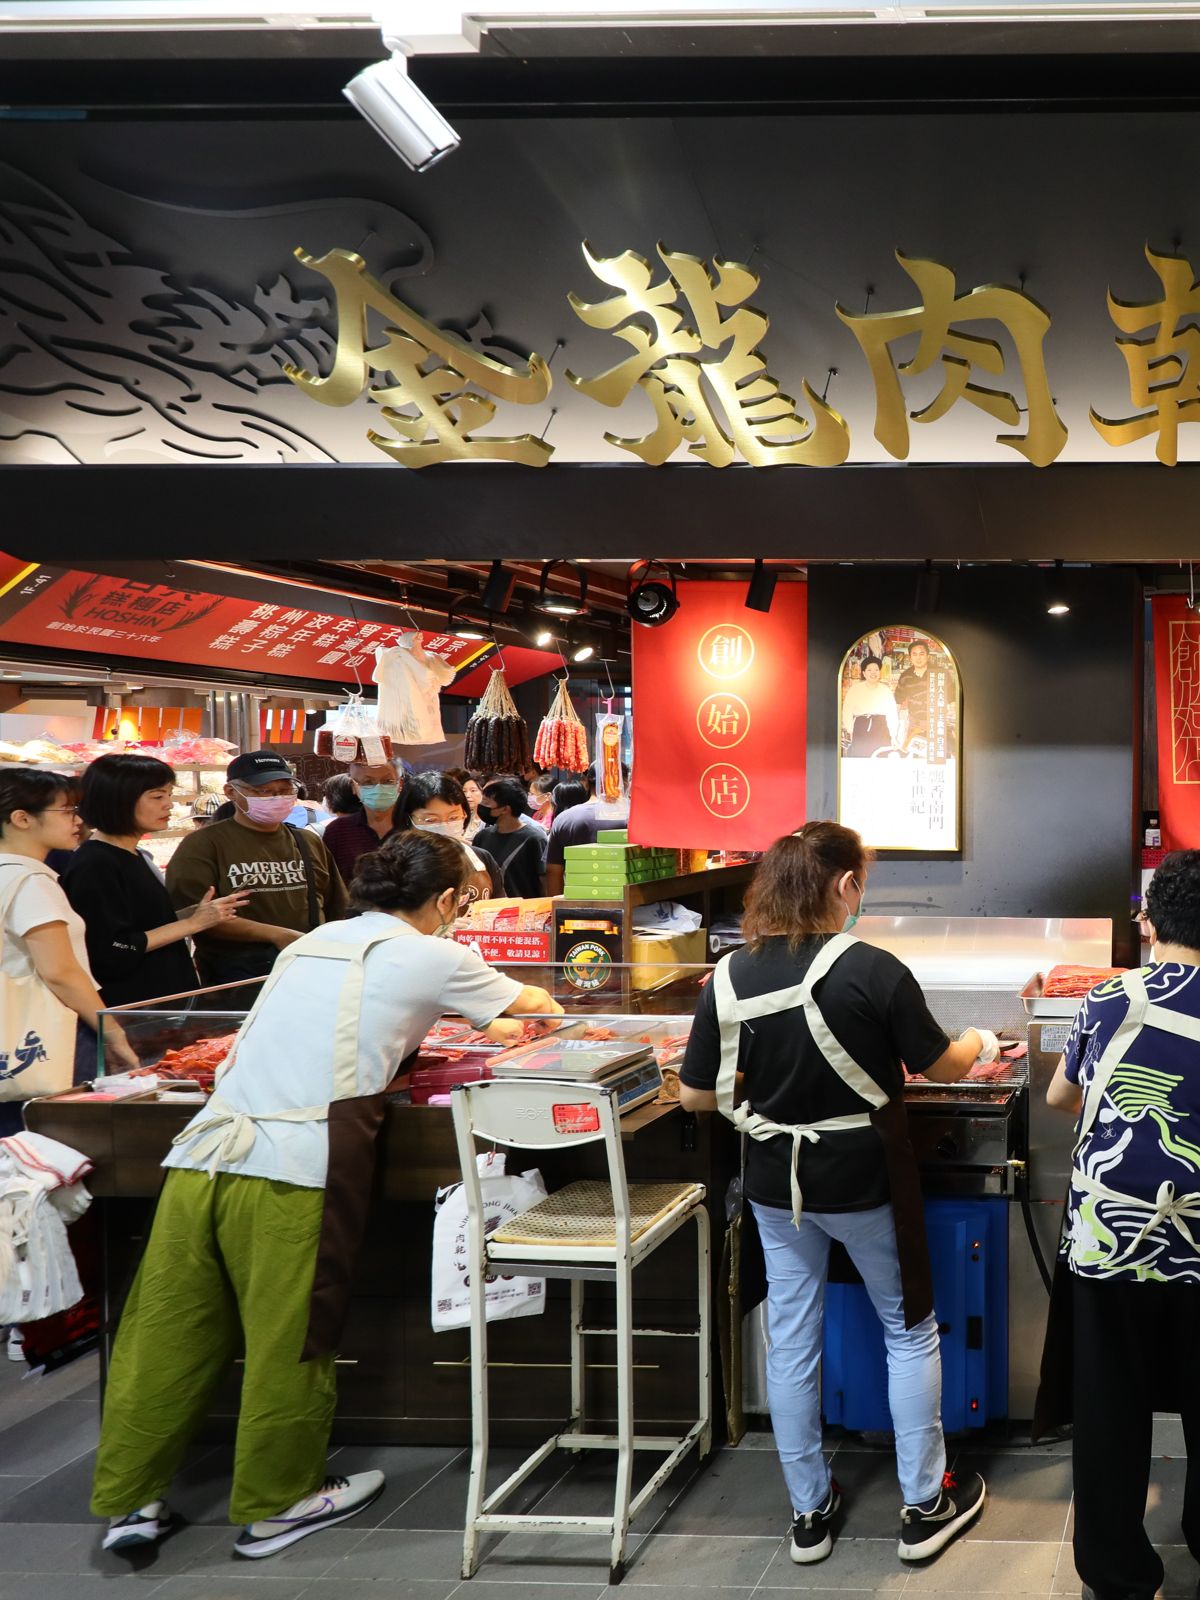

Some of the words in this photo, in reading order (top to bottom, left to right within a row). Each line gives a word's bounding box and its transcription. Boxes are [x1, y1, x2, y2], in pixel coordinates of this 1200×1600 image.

[20, 574, 52, 595] 1F-41
[83, 607, 163, 628] HOSHIN
[706, 633, 743, 808] 創始店
[230, 872, 283, 888] LOVE
[569, 943, 590, 958] TAIWAN
[590, 944, 606, 957] PORK
